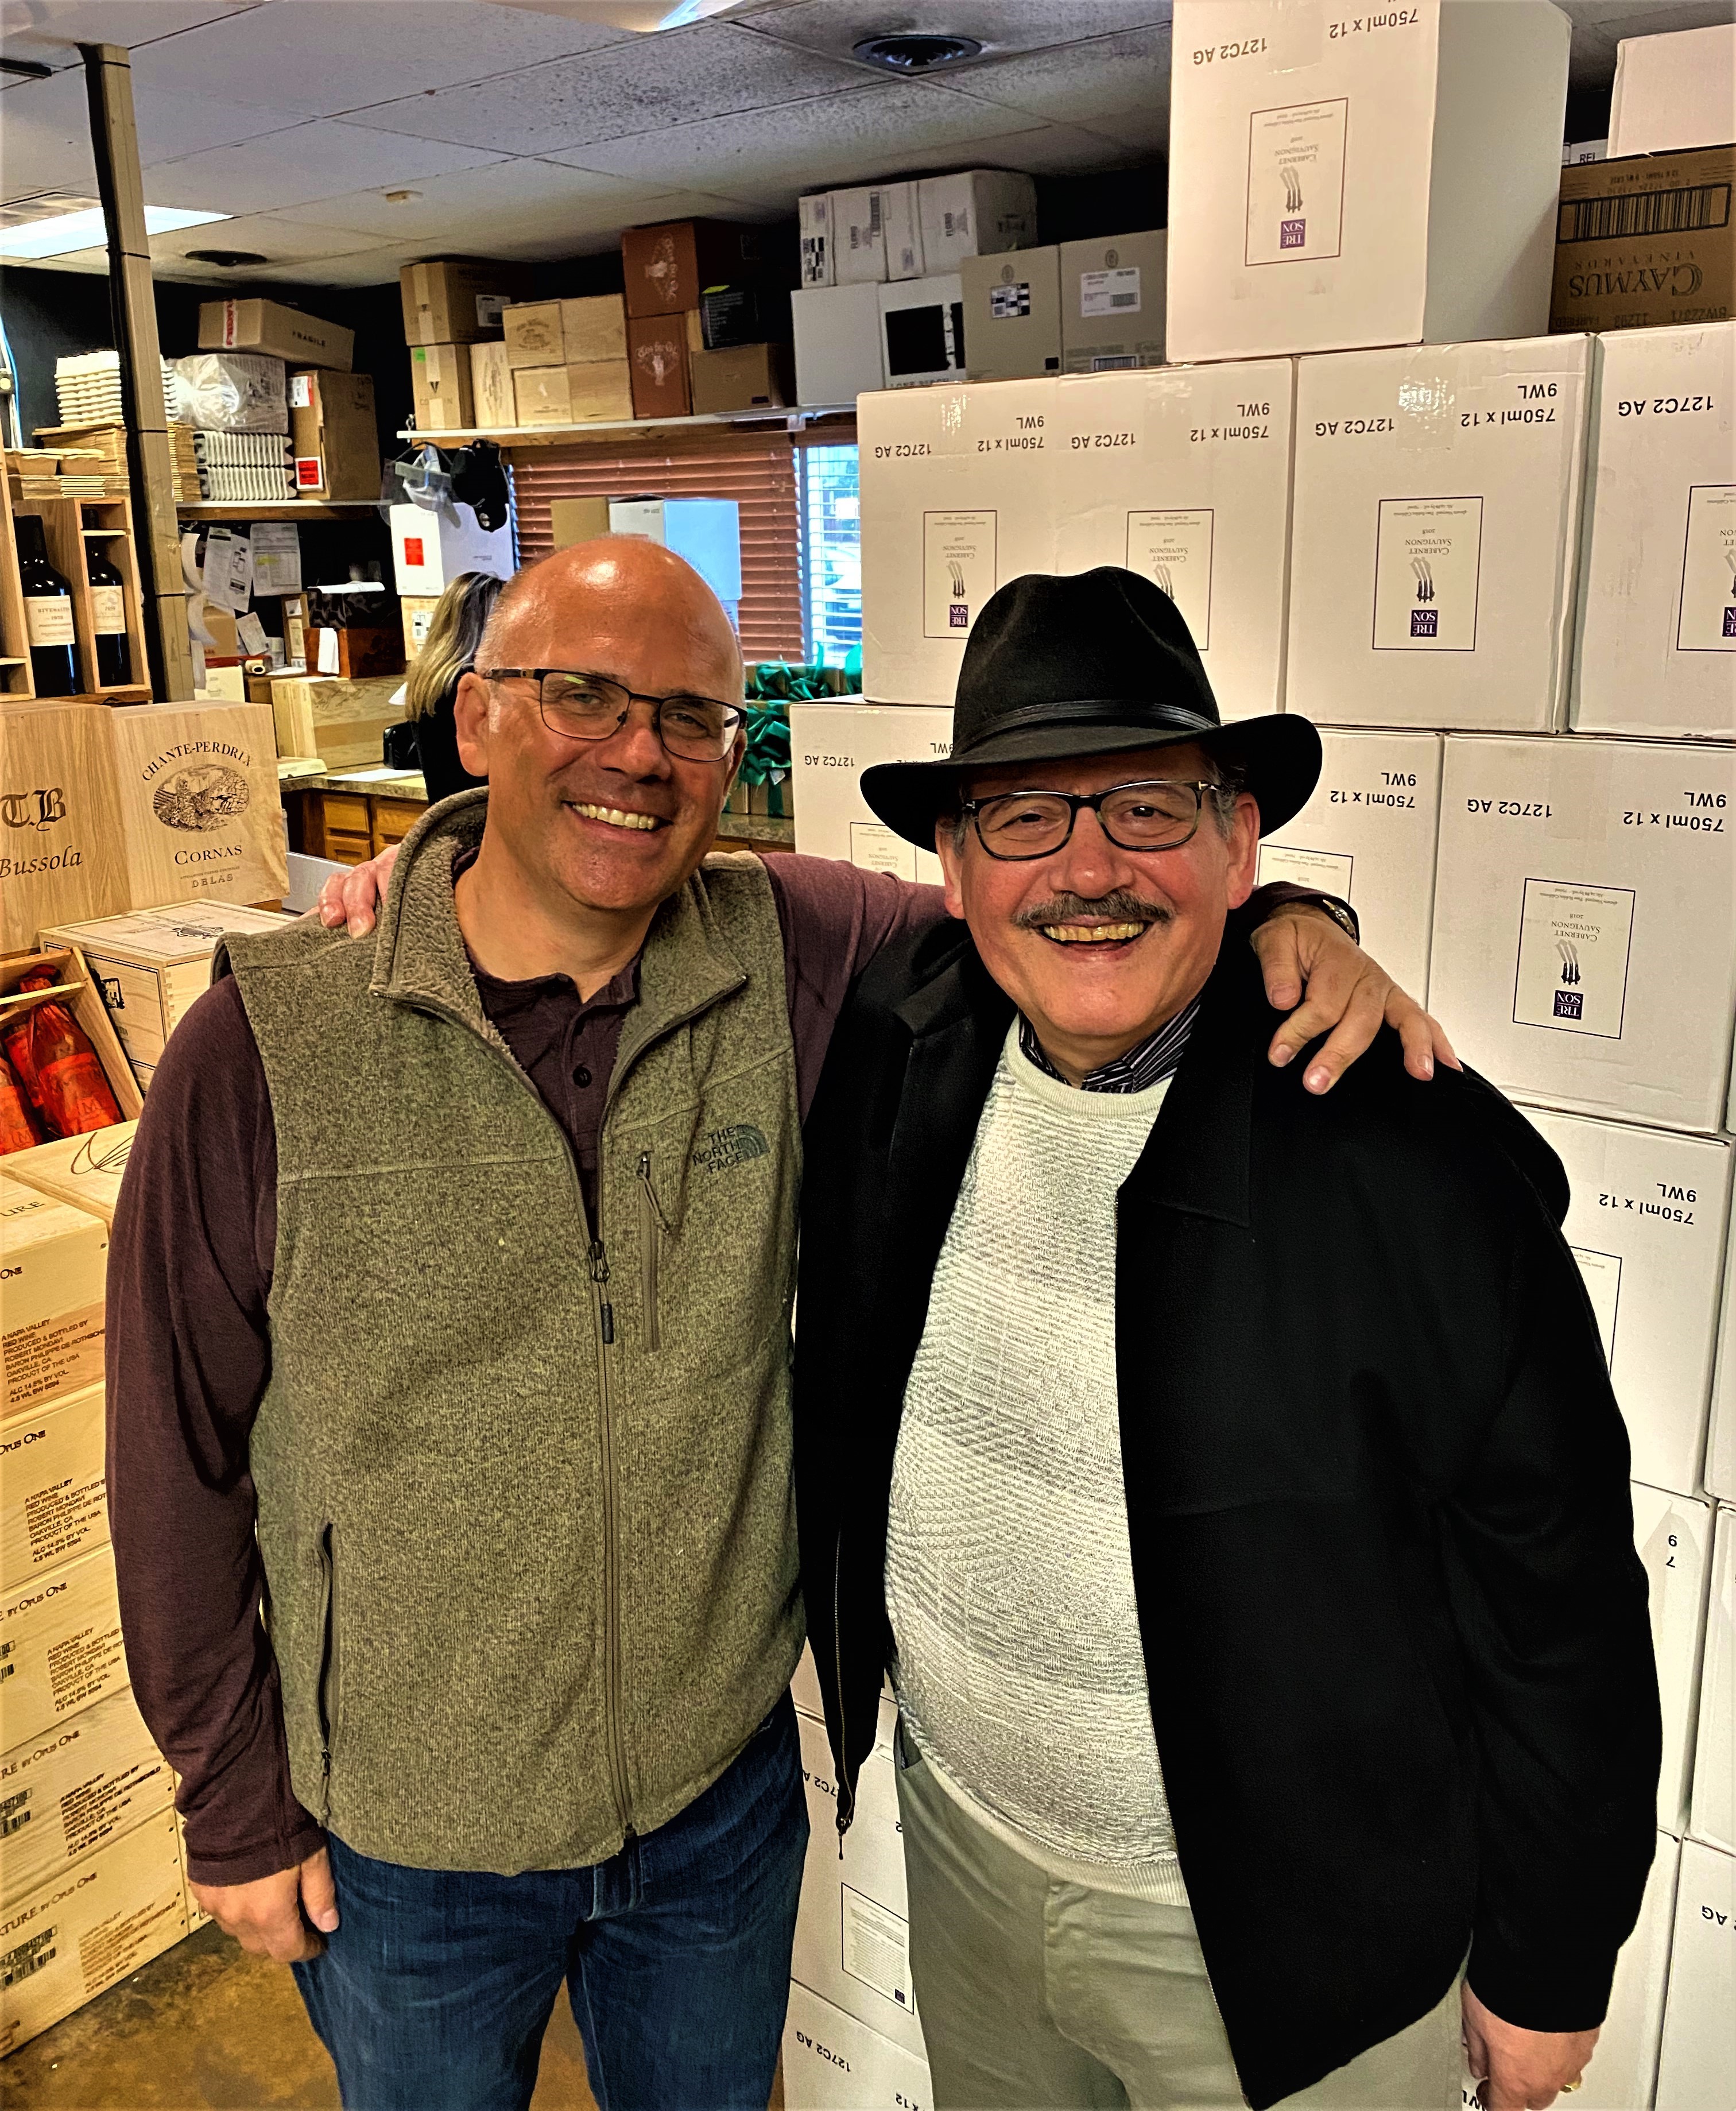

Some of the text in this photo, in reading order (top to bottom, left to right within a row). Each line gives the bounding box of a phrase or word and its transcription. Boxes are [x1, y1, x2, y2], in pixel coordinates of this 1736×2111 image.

[1330, 8, 1419, 39] 750ml x 12
[1193, 37, 1268, 65] 127C2 AG
[1282, 221, 1304, 232] SON
[1574, 251, 1695, 269] VINEYARDS
[1569, 264, 1703, 297] CAYMUS
[293, 331, 327, 347] FRAGILE
[1517, 383, 1557, 399] 9WL
[1237, 402, 1270, 417] 9WL
[1618, 396, 1714, 417] 127C2 AG
[1016, 416, 1044, 429] 9WL
[1461, 408, 1556, 427] 750ml x 12
[1190, 425, 1269, 442] 750ml x 12
[1315, 418, 1394, 436] 127C2 AG
[978, 436, 1044, 452] 750ml x 12
[1071, 433, 1136, 450] 127C2 AG
[875, 444, 932, 458] 127C2 AG
[1149, 547, 1188, 555] SAUVIGNON
[1405, 537, 1453, 547] SAUVIGNON
[946, 552, 975, 560] CABERNET
[1152, 554, 1187, 563] CABERNET
[1408, 547, 1450, 556] CABERNET
[1412, 611, 1436, 622] SON
[1412, 624, 1435, 636] TRÉ
[142, 741, 251, 781] CHANTE-PERDRIX
[804, 755, 855, 767] 127C2 AG
[1381, 772, 1417, 787] 9WL
[1330, 791, 1415, 809] 750ml x 12
[1467, 799, 1552, 818] 127C2 AG
[1684, 792, 1727, 808] 9WL
[1623, 811, 1724, 832] 750ml x 12
[0, 845, 83, 877] Bussola
[175, 845, 242, 865] CORNAS
[191, 874, 234, 888] DELAS
[1551, 921, 1601, 934] SAUVIGNON
[1553, 929, 1598, 942] CABERNET
[1557, 992, 1580, 1004] SON
[1556, 1005, 1579, 1016] TRÉ
[707, 1126, 736, 1144] THE
[692, 1138, 741, 1166] NORTH
[708, 1151, 743, 1173] FACE
[1656, 1183, 1697, 1203] 9WL
[1599, 1194, 1694, 1225] 750ml x 12
[7, 1328, 25, 1339] NAPA
[26, 1319, 50, 1331] VALLEY
[3, 1332, 35, 1348] RED WINE
[3, 1338, 41, 1356] PRODUCED
[49, 1324, 78, 1339] BOTTLED
[5, 1337, 63, 1363] ROBERT MONDAVI
[6, 1358, 29, 1370] BARON
[31, 1346, 60, 1361] PHILIPPE
[8, 1368, 40, 1385] PRODUCT
[52, 1359, 65, 1368] THE
[67, 1354, 79, 1362] USA
[44, 1374, 53, 1382] BY
[24, 1430, 46, 1444] ONE
[31, 1490, 48, 1501] NAPA
[49, 1478, 72, 1492] VALLEY
[26, 1493, 59, 1511] RED WINE
[27, 1497, 64, 1518] PRODUCED
[71, 1481, 100, 1498] BOTTLED
[28, 1509, 54, 1524] ROBERT
[56, 1495, 85, 1512] MONDAVI
[29, 1517, 52, 1532] BARON
[53, 1504, 82, 1521] PHILIPPE
[30, 1527, 62, 1546] PRODUCT
[74, 1516, 86, 1525] THE
[88, 1510, 100, 1519] USA
[66, 1532, 75, 1540] BY
[19, 1593, 44, 1610] OPUS
[46, 1582, 67, 1597] ONE
[33, 1742, 57, 1761] OPUS
[59, 1730, 80, 1746] ONE
[814, 1776, 838, 1797] 7C2
[1702, 1905, 1728, 1926] AG
[796, 2031, 851, 2072] 127C2 AG
[896, 2093, 909, 2108] 12
